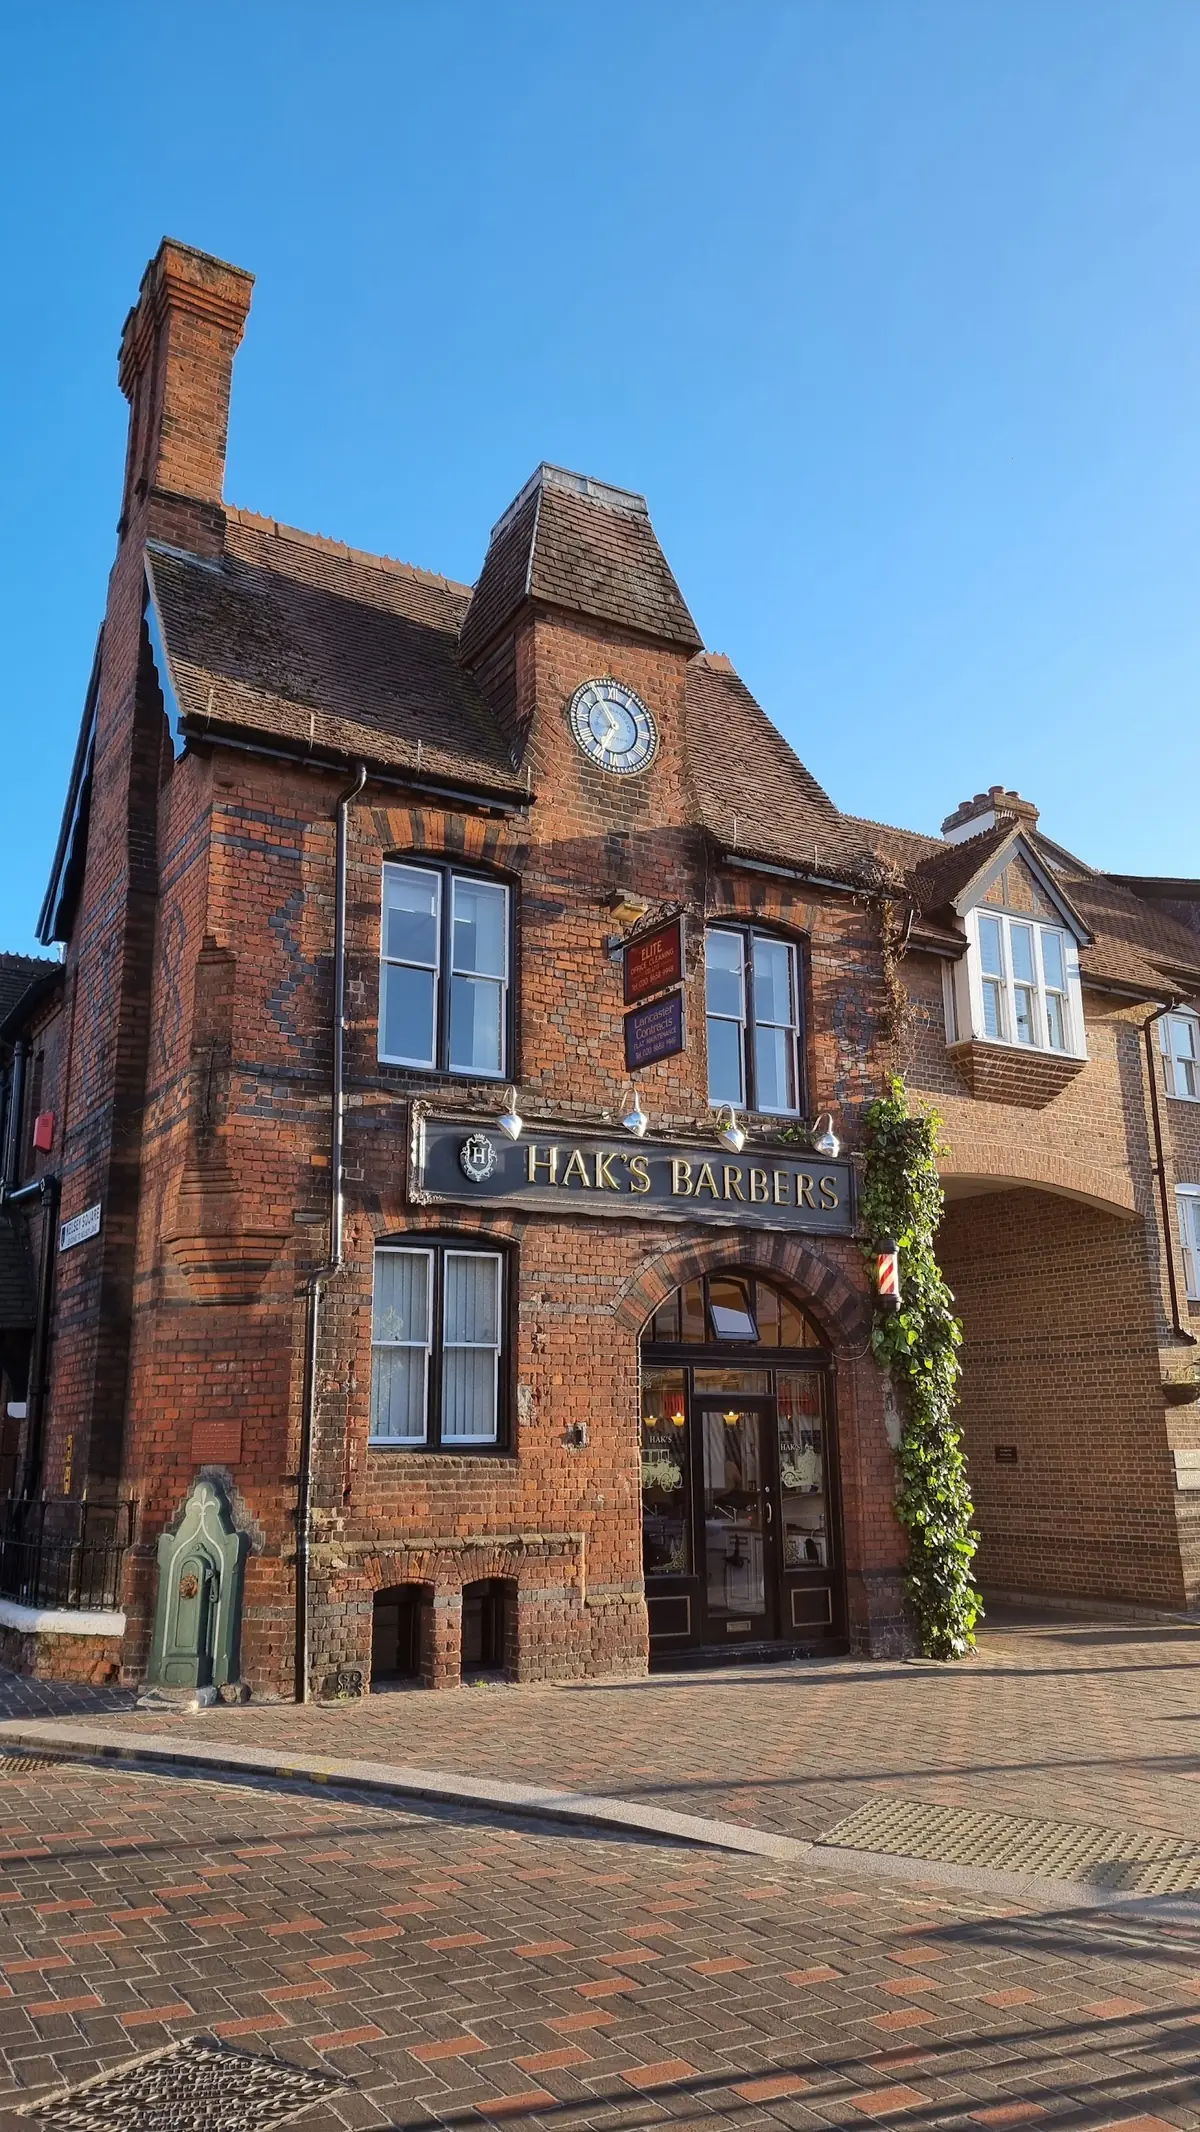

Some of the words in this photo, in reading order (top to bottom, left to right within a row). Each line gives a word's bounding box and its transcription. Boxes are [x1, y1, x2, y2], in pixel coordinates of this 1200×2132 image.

[630, 961, 647, 975] OFFICE
[648, 947, 674, 966] CLEANING
[641, 940, 662, 961] ELITE
[634, 1004, 675, 1029] Lancaster
[635, 1017, 673, 1040] Contracts
[646, 1026, 677, 1045] MAINTENANCE
[472, 1146, 487, 1164] H
[527, 1144, 651, 1194] HAK'S
[671, 1159, 839, 1210] BARBERS
[649, 1435, 673, 1444] HAK'S
[780, 1443, 801, 1451] HAK'S
